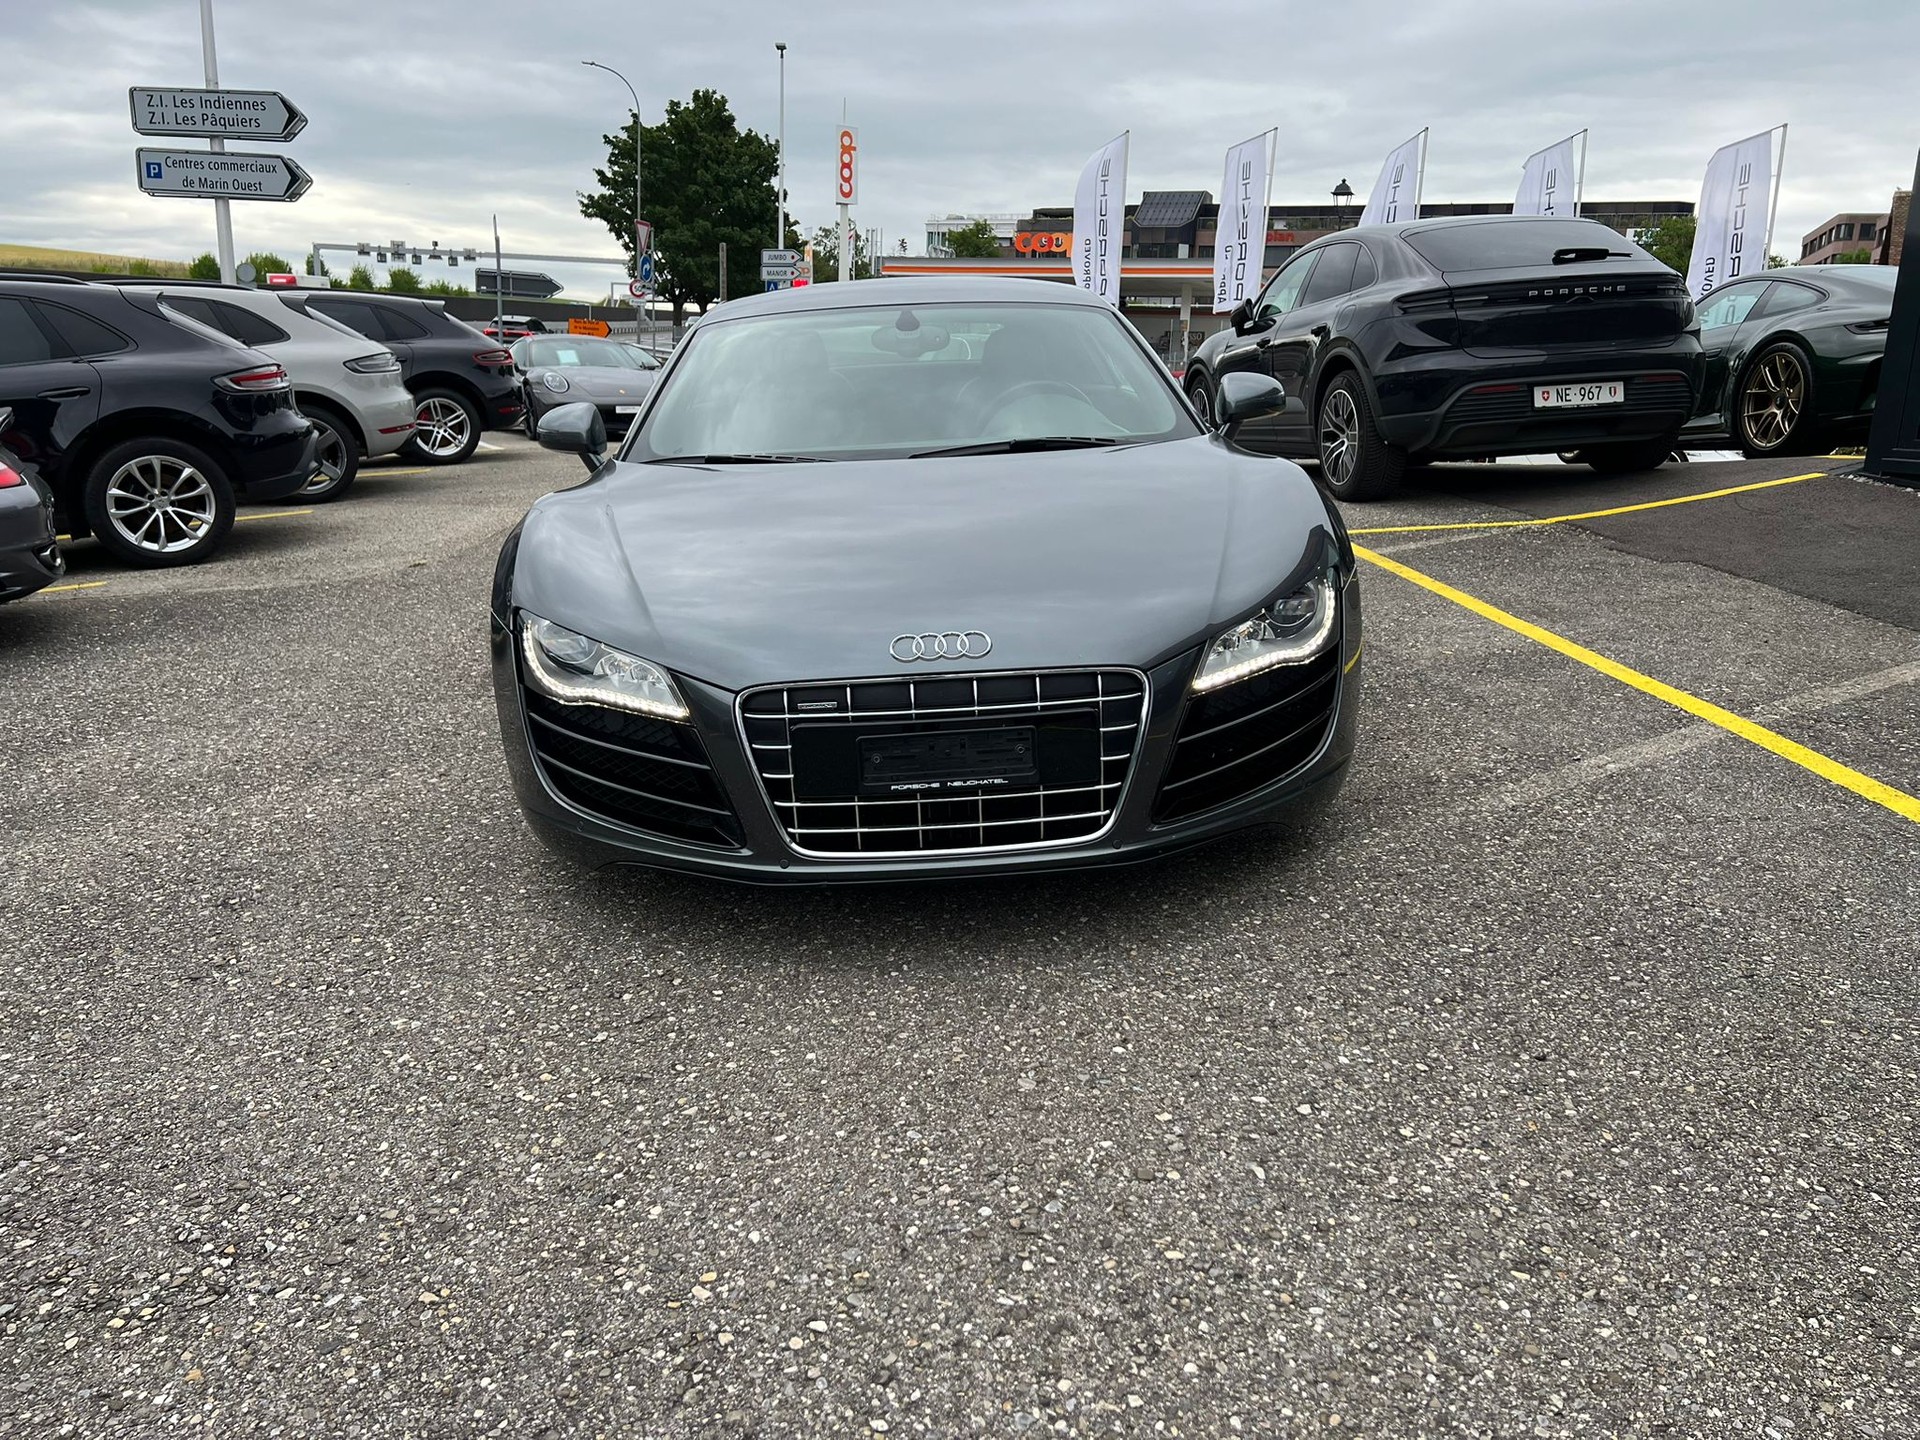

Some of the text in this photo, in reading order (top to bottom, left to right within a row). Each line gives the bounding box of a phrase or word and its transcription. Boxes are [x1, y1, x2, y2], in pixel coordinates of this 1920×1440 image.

[146, 94, 267, 111] Z.I. Les Indiennes
[148, 111, 261, 130] Z.I. Les Pâquiers
[165, 156, 278, 174] Centres commerciaux
[840, 130, 857, 199] coop
[182, 176, 263, 192] de Marin Ouest
[1529, 285, 1626, 297] PORSCHE
[891, 778, 1009, 791] PORSCHE NEUCHATEL
